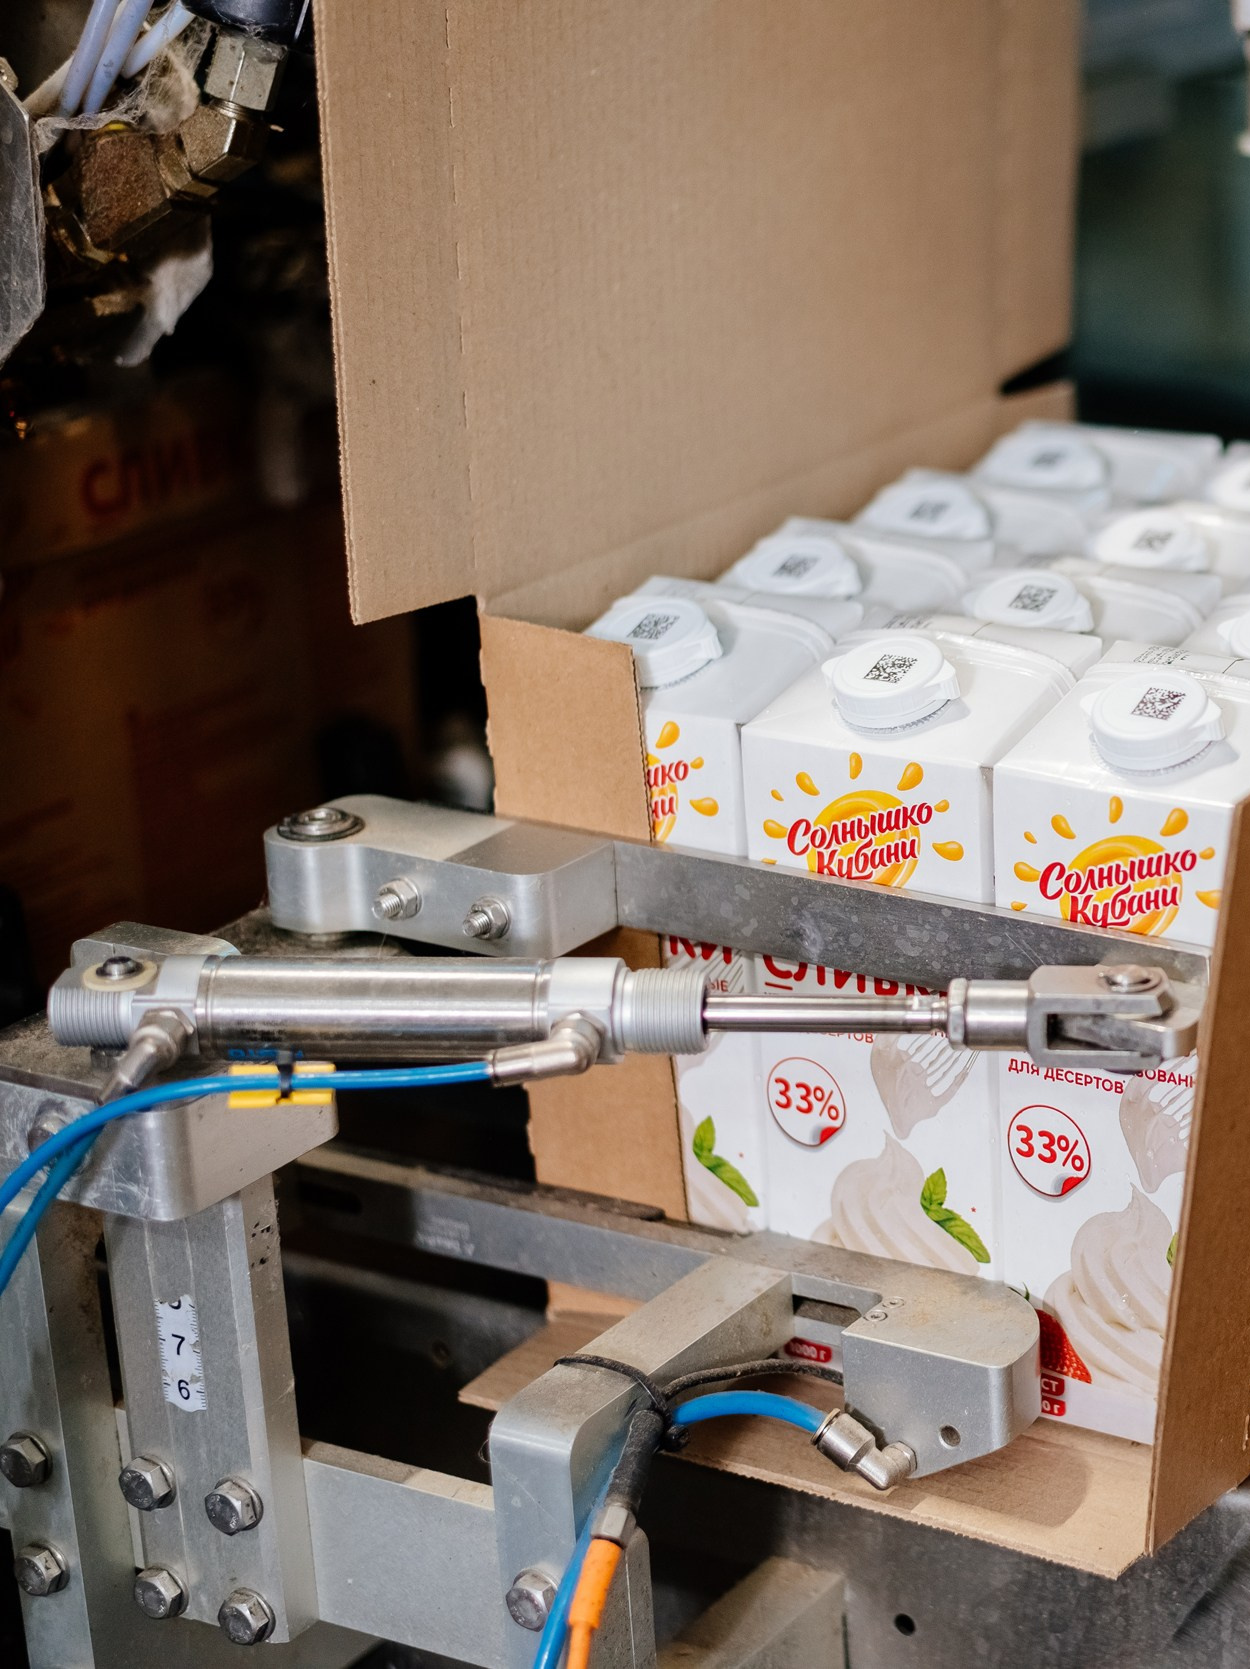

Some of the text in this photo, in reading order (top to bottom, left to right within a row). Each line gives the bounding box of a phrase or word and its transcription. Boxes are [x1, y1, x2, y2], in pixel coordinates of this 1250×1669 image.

[787, 802, 933, 856] Солнышко
[816, 837, 918, 880] Кубани
[1039, 849, 1198, 900] Солнышко
[1069, 884, 1179, 928] Кубани
[1008, 1058, 1124, 1095] ДЛЯ ДЕСЕРТОВ
[774, 1077, 840, 1121] 33%
[1016, 1124, 1085, 1172] 33%
[171, 1333, 186, 1356] 7
[178, 1379, 191, 1401] 6
